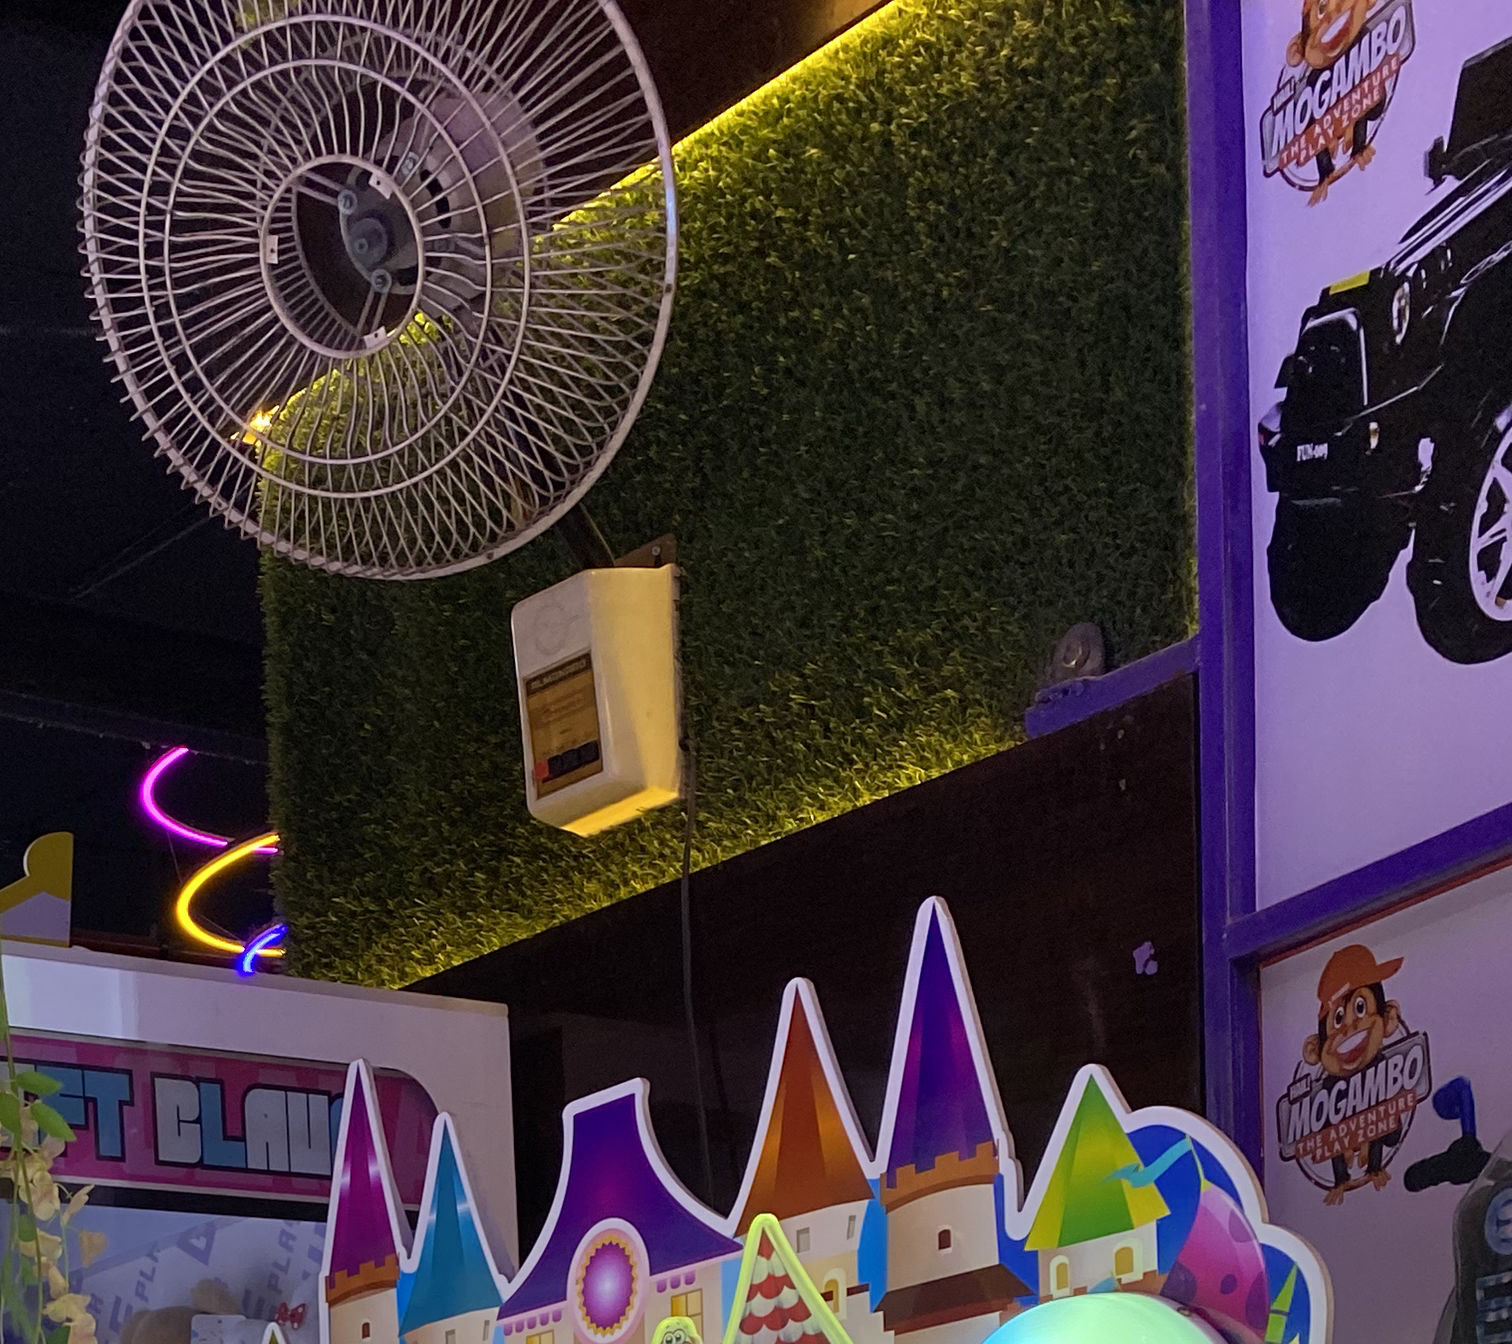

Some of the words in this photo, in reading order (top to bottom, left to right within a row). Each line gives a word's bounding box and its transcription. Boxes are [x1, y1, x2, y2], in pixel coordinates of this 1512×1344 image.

[1271, 5, 1407, 159] MOGAMBO
[1281, 137, 1306, 164] THE
[1313, 56, 1399, 139] ADVENTURE
[1299, 124, 1335, 164] PLAY
[1341, 87, 1381, 128] ZONE
[1287, 1044, 1424, 1145] MOGAMBO
[1297, 1134, 1323, 1155] THE
[1329, 1093, 1414, 1142] ADVENTURE
[1315, 1137, 1350, 1161] PLAY
[1357, 1116, 1397, 1143] ZONE
